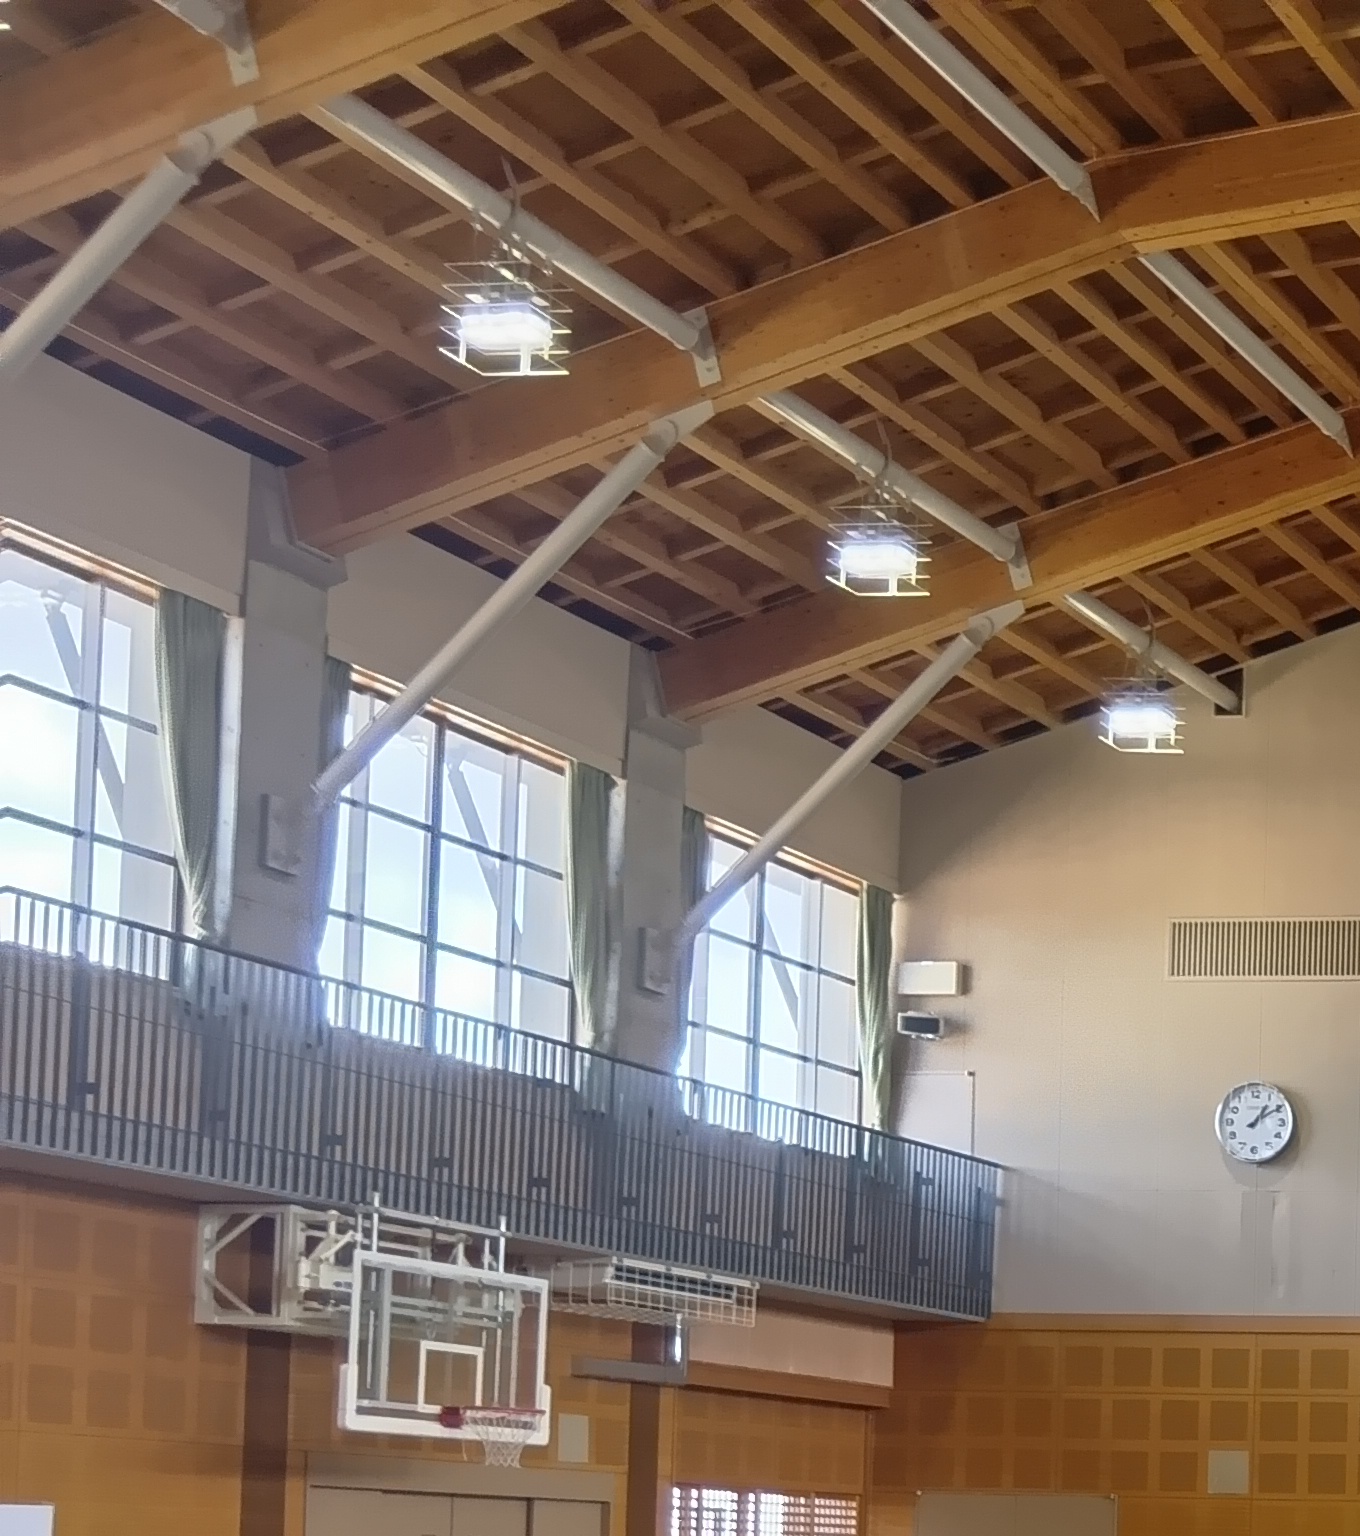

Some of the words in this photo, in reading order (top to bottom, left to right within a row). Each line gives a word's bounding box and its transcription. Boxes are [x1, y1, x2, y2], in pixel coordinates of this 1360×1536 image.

[1277, 1118, 1286, 1127] 3
[1274, 1131, 1282, 1139] 4
[1238, 1142, 1247, 1150] 7
[1250, 1146, 1258, 1154] 6
